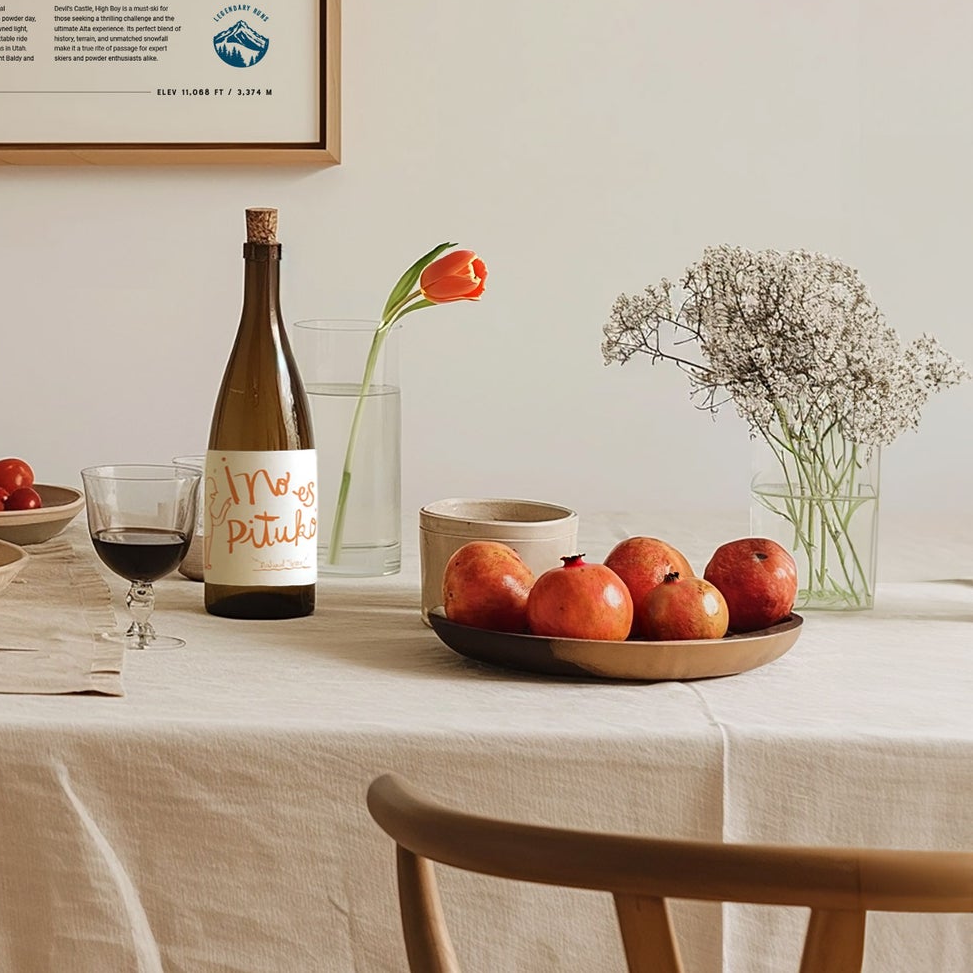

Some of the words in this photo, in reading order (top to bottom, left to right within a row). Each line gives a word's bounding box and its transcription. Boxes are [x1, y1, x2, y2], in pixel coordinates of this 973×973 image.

[94, 5, 109, 14] High
[109, 5, 122, 13] Boy
[213, 4, 251, 22] LEGENDARY
[253, 8, 269, 22] RUNS
[1, 15, 24, 23] powder
[71, 15, 95, 23] seeking
[100, 15, 123, 23] thrilling
[123, 15, 152, 23] challenge
[135, 25, 157, 33] perfect
[143, 35, 169, 43] snowfall
[112, 45, 139, 53] passage
[148, 45, 168, 53] expert
[5, 54, 23, 63] Baldy
[156, 88, 177, 96] ELEV
[214, 88, 224, 96] FT
[227, 88, 233, 96] /
[265, 88, 273, 96] M
